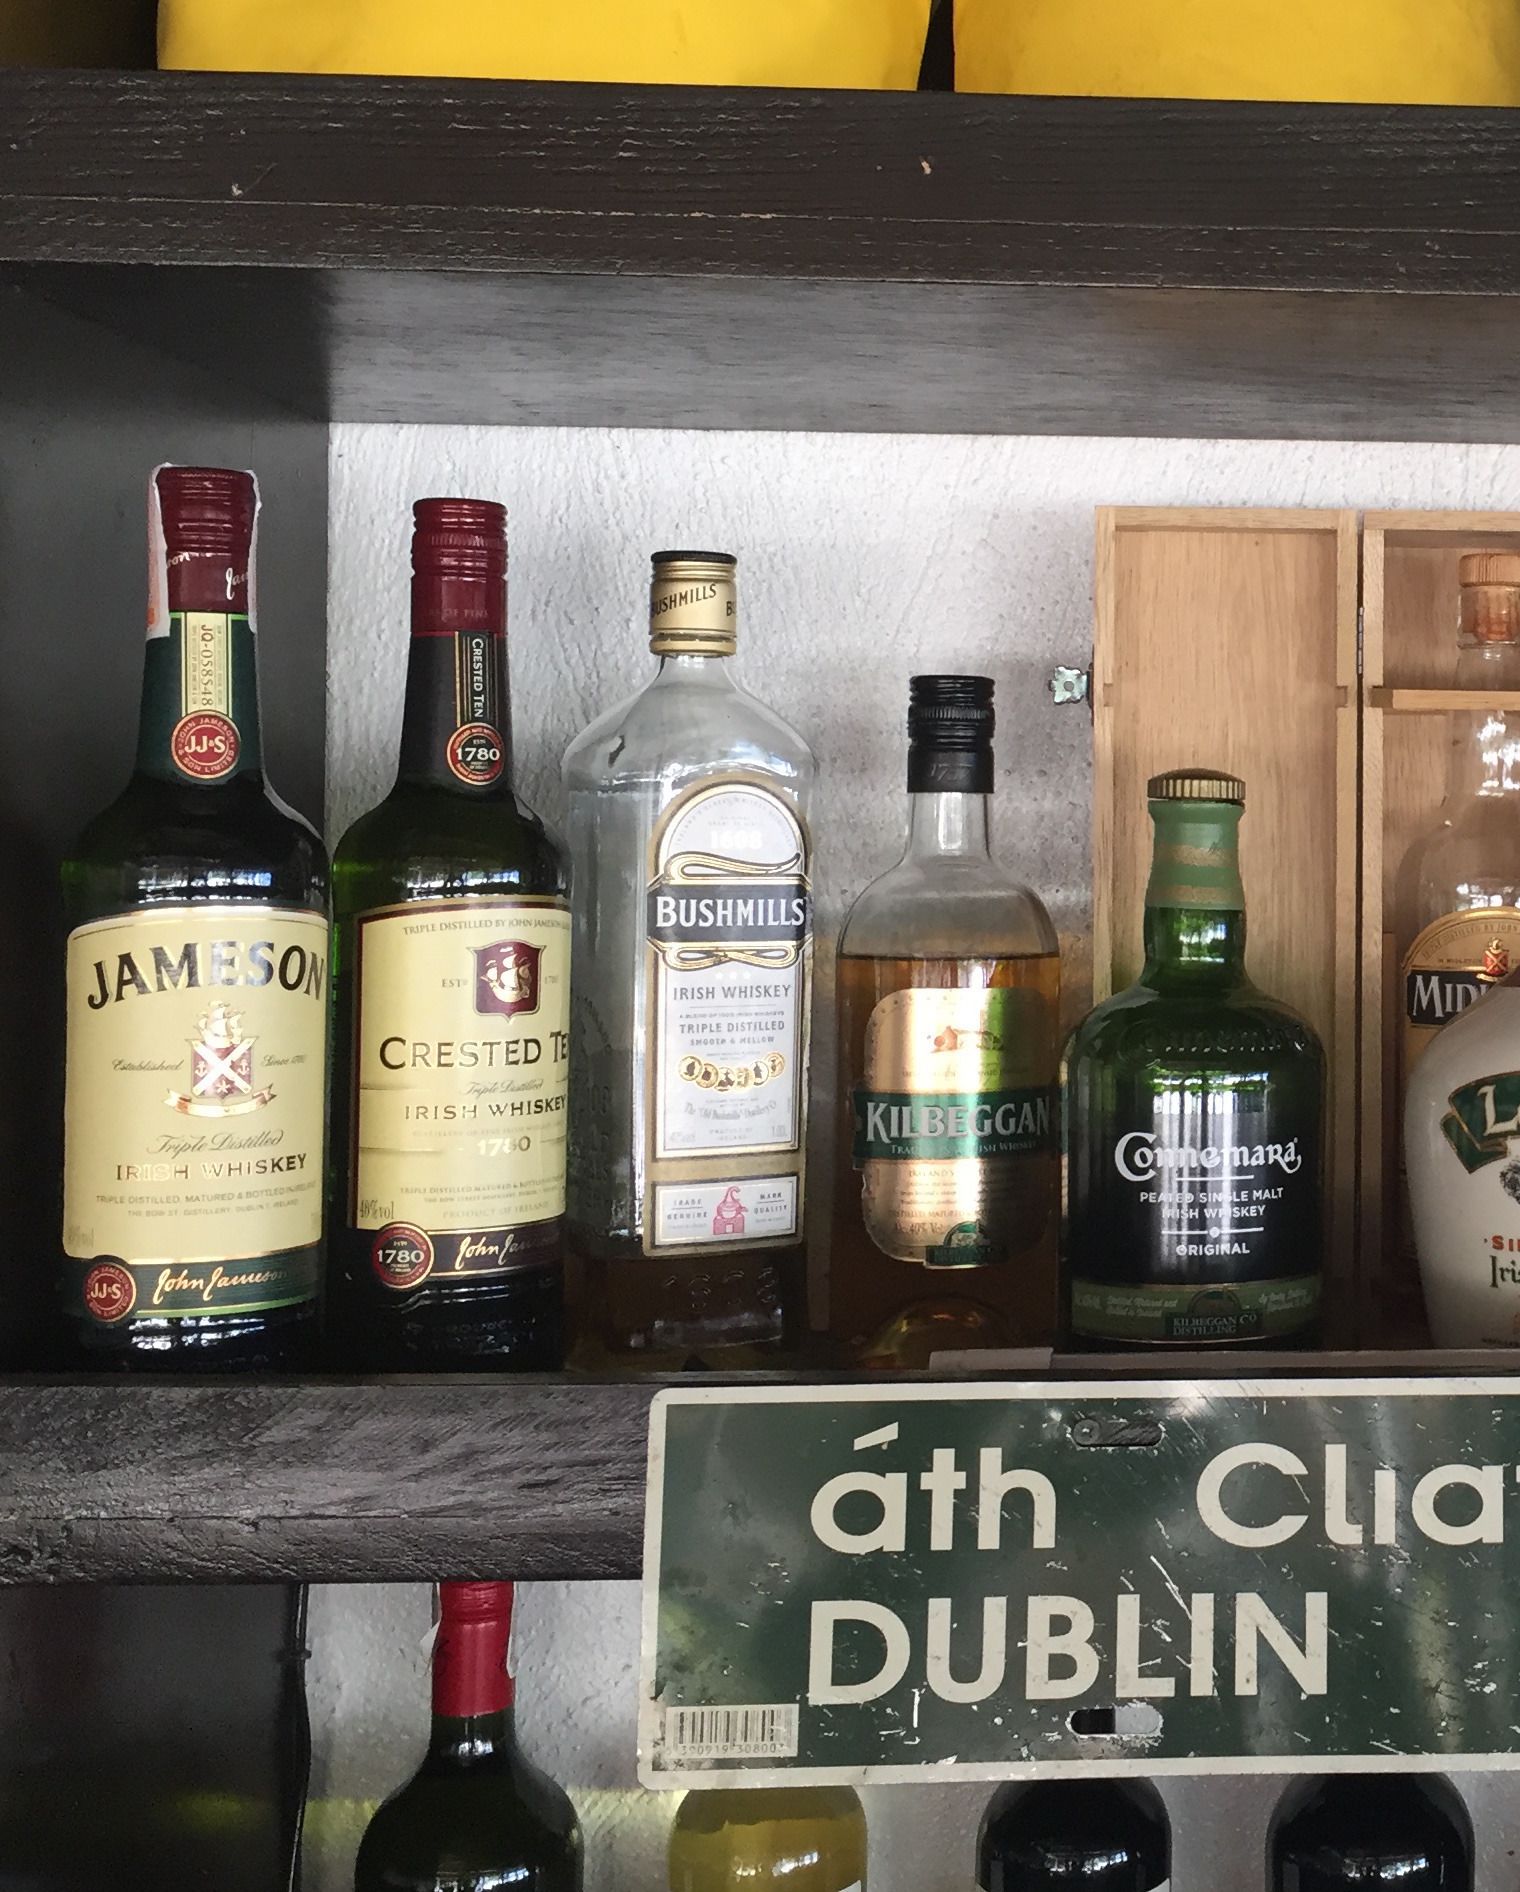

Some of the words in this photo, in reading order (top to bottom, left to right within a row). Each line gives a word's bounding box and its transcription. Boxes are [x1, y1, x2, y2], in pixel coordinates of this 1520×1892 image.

[472, 638, 484, 691] CRESTED
[473, 694, 484, 718] TEN
[456, 747, 500, 761] 1780
[656, 896, 805, 928] BUSHMILLS
[404, 924, 436, 936] TRIPLE
[439, 920, 493, 932] DISTILLED
[495, 919, 505, 928] BY
[508, 919, 533, 929] JOHN
[87, 940, 326, 1010] JAMESON
[673, 986, 716, 1001] IRISH
[721, 984, 792, 999] WHISKEY
[680, 1023, 722, 1034] TRIPLE
[727, 1021, 785, 1033] DISTILLED
[379, 1036, 541, 1070] CRESTED
[405, 1104, 478, 1120] IRISH
[488, 1094, 567, 1117] WHISKEY
[866, 1096, 1050, 1144] KILBEGGAN
[147, 1134, 208, 1159] Triple
[210, 1129, 285, 1152] Distilled
[116, 1163, 190, 1182] IRISH
[202, 1153, 308, 1182] WHISKEY
[96, 1194, 125, 1205] TRIPLE
[185, 1192, 235, 1203] MATURED
[759, 1192, 782, 1200] MARK
[1140, 1190, 1195, 1203] PEATED
[1199, 1190, 1249, 1203] SINGLE
[1252, 1187, 1284, 1200] MALT
[754, 1205, 788, 1215] QUALITY
[1161, 1208, 1199, 1220] IRISH
[1203, 1205, 1266, 1219] WHISKEY
[377, 1249, 426, 1264] 1780
[454, 1235, 499, 1271] John
[1176, 1242, 1250, 1257] ORIGINAL
[153, 1268, 204, 1305] John
[203, 1266, 288, 1301] Jameson
[1173, 1315, 1238, 1328] KILBEGGAN
[1173, 1324, 1237, 1337] DISTILLING
[808, 1421, 1058, 1554] áth
[808, 1589, 1329, 1706] DUBLIN
